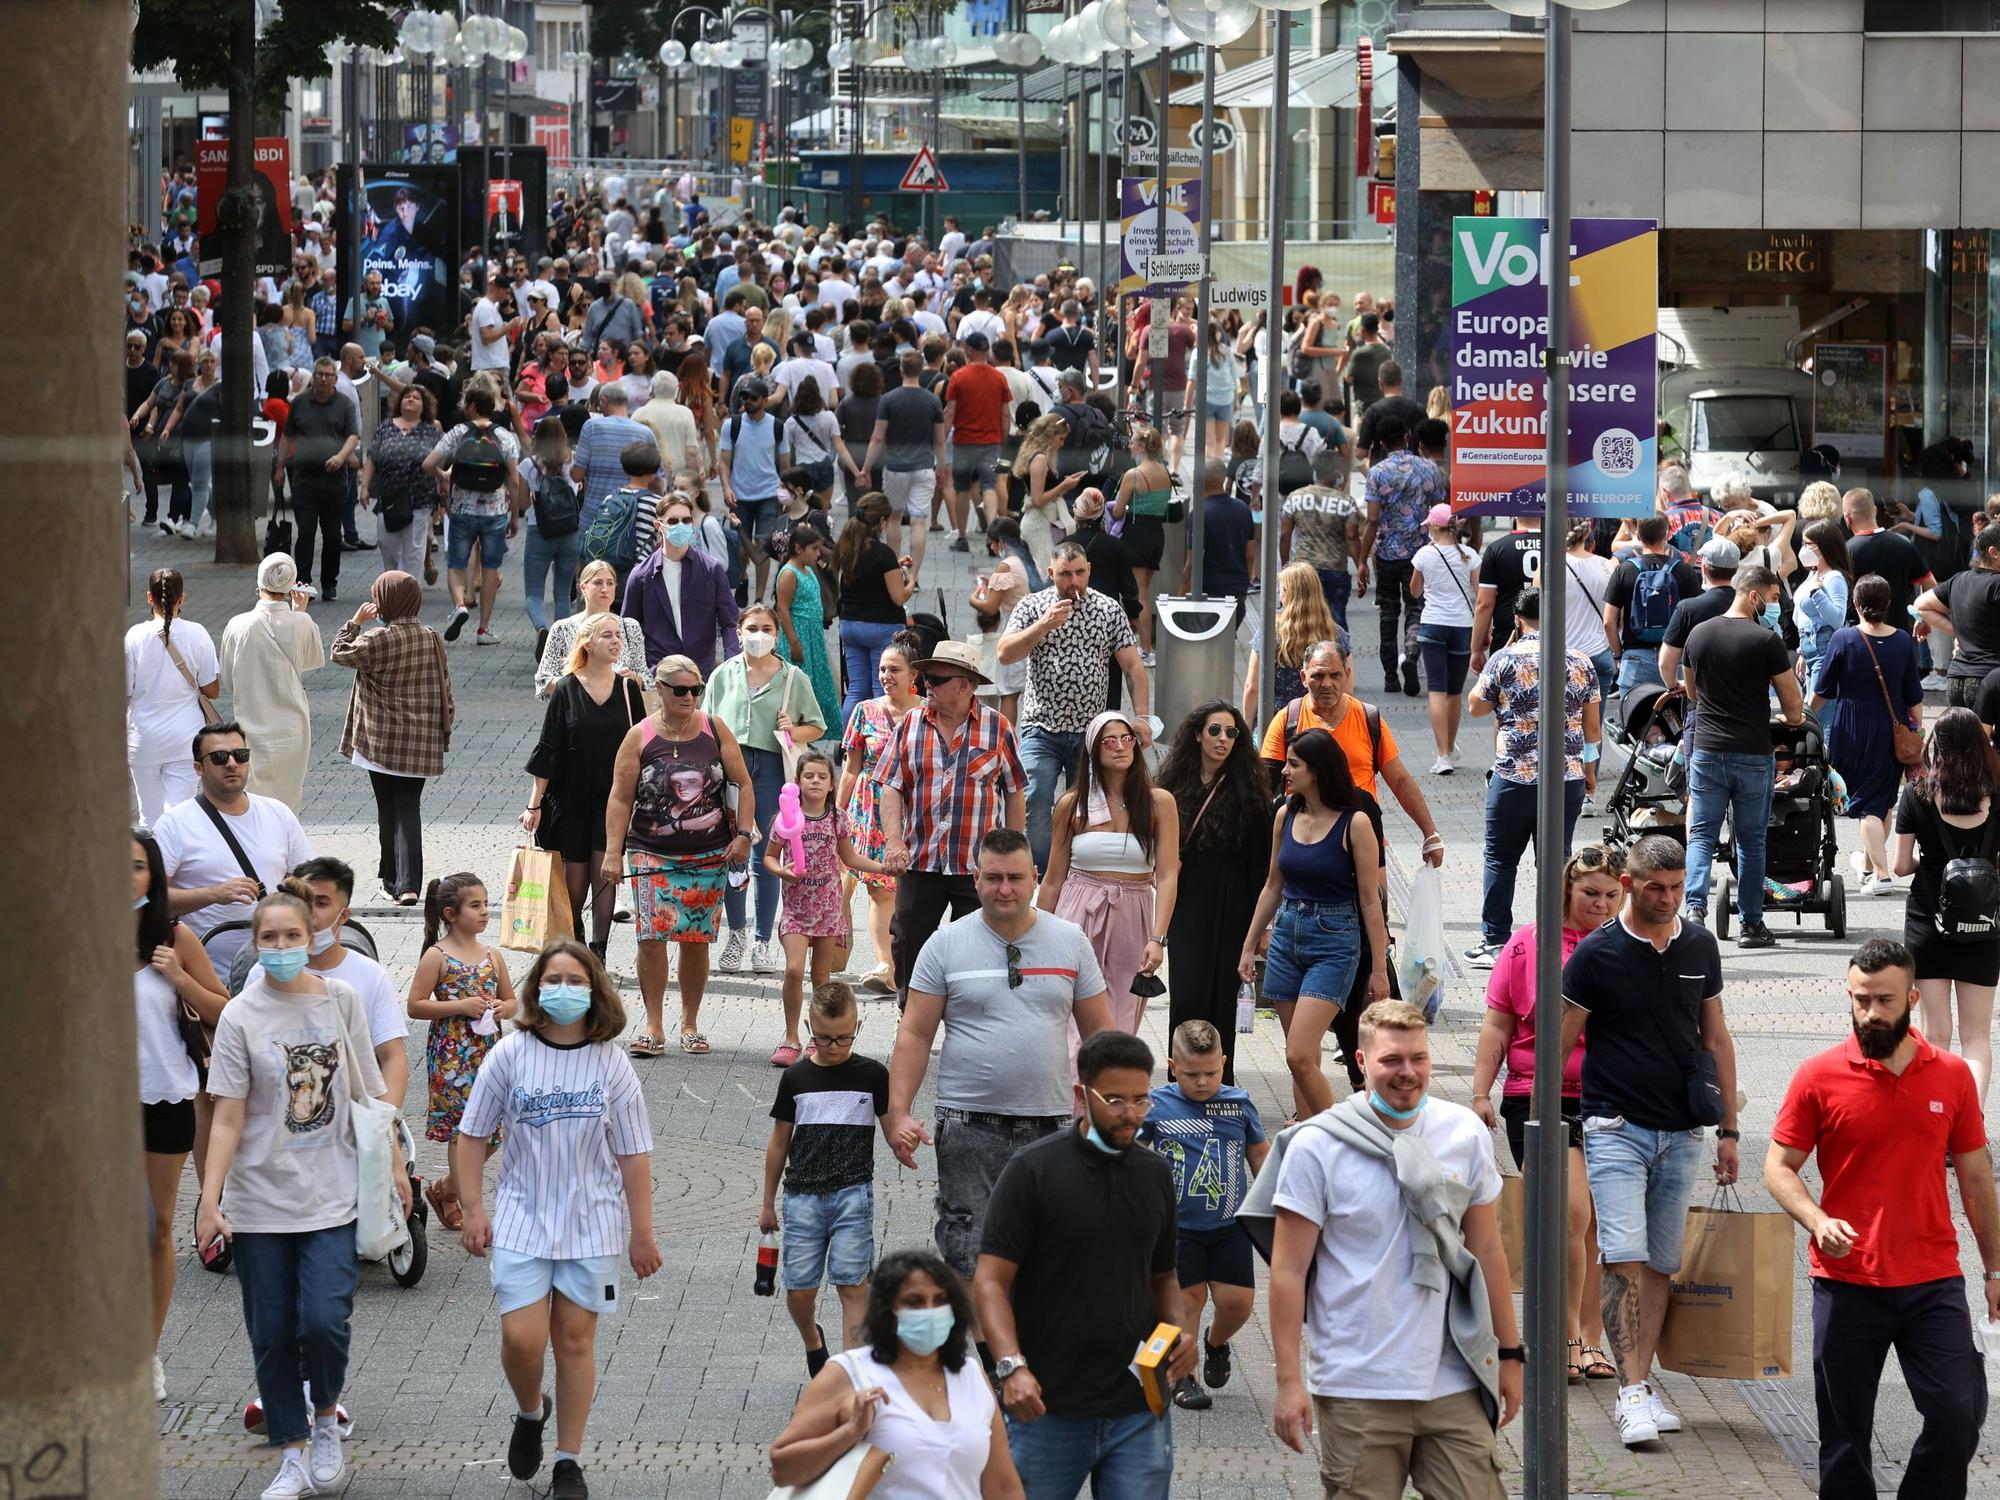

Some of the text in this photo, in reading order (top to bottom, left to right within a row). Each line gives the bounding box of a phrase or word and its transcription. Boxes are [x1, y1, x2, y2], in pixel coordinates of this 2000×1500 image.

[200, 150, 229, 163] SAN
[1140, 150, 1199, 163] Perleäßchen
[1133, 226, 1191, 236] Investren in
[1129, 238, 1147, 246] eine
[255, 264, 274, 273] SPD
[364, 259, 433, 269] Deins. Meins.
[1151, 261, 1200, 280] Schildergasse
[1457, 311, 1549, 340] Europa
[1456, 376, 1534, 401] heute
[1456, 410, 1572, 435] Zukunf.
[1462, 452, 1543, 462] #GenerationEuropa
[1456, 491, 1642, 504] ZUKUNFT ME IN EUROPE
[1957, 922, 1991, 933] PUMA
[514, 1081, 604, 1119] Originals
